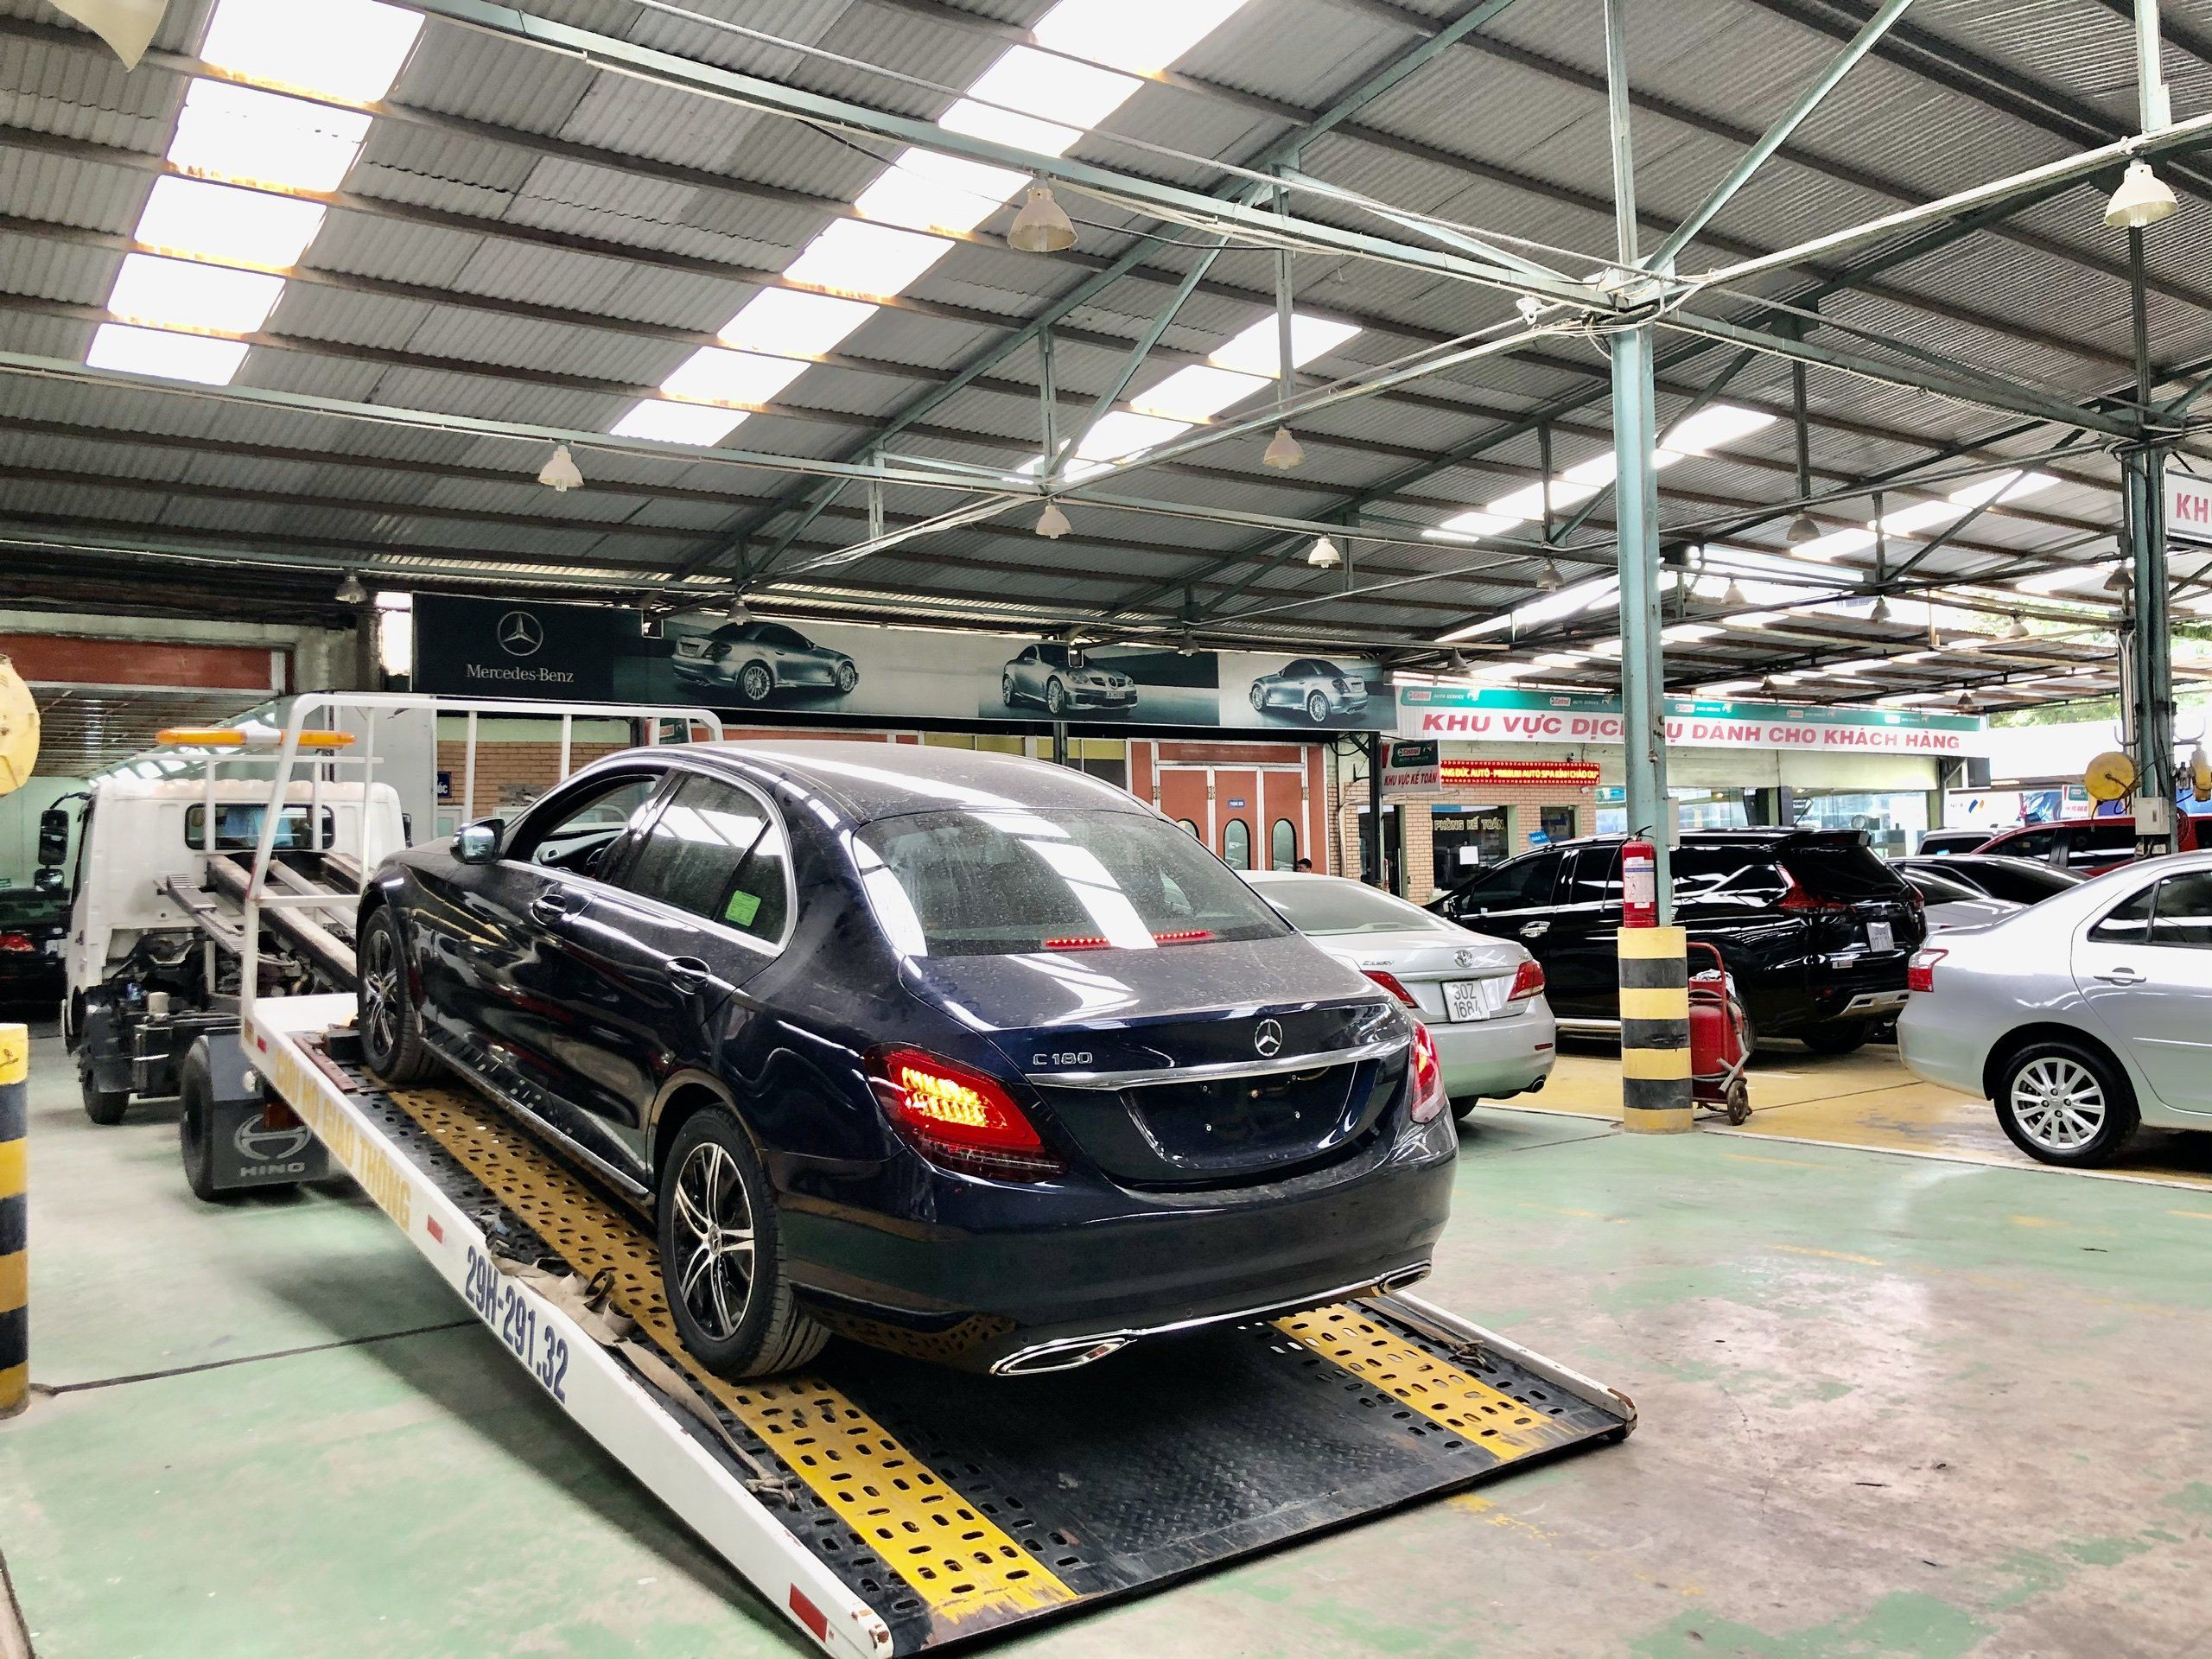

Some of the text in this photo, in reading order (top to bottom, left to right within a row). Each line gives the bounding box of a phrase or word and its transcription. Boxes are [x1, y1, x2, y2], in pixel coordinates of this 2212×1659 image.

[2177, 493, 2212, 524] KH
[466, 664, 575, 683] Mercedes-Benz
[1423, 714, 1491, 732] KHU
[1503, 714, 1562, 739] VỰC
[1667, 722, 1683, 742] Ụ
[1692, 721, 1762, 741] DÀNH
[1768, 727, 1816, 744] CHO
[1823, 726, 1898, 747] KHÁCH
[1905, 732, 1960, 749] HÀNG
[1384, 767, 1438, 788] KHU VỰC KẾ TOÁN
[1434, 815, 1504, 831] PHÒNG KẾ TOÁN
[1452, 982, 1477, 1000] 30Z
[1033, 1052, 1093, 1065] C 180
[240, 1162, 305, 1177] HINO
[465, 1244, 569, 1405] 29H-291.32
